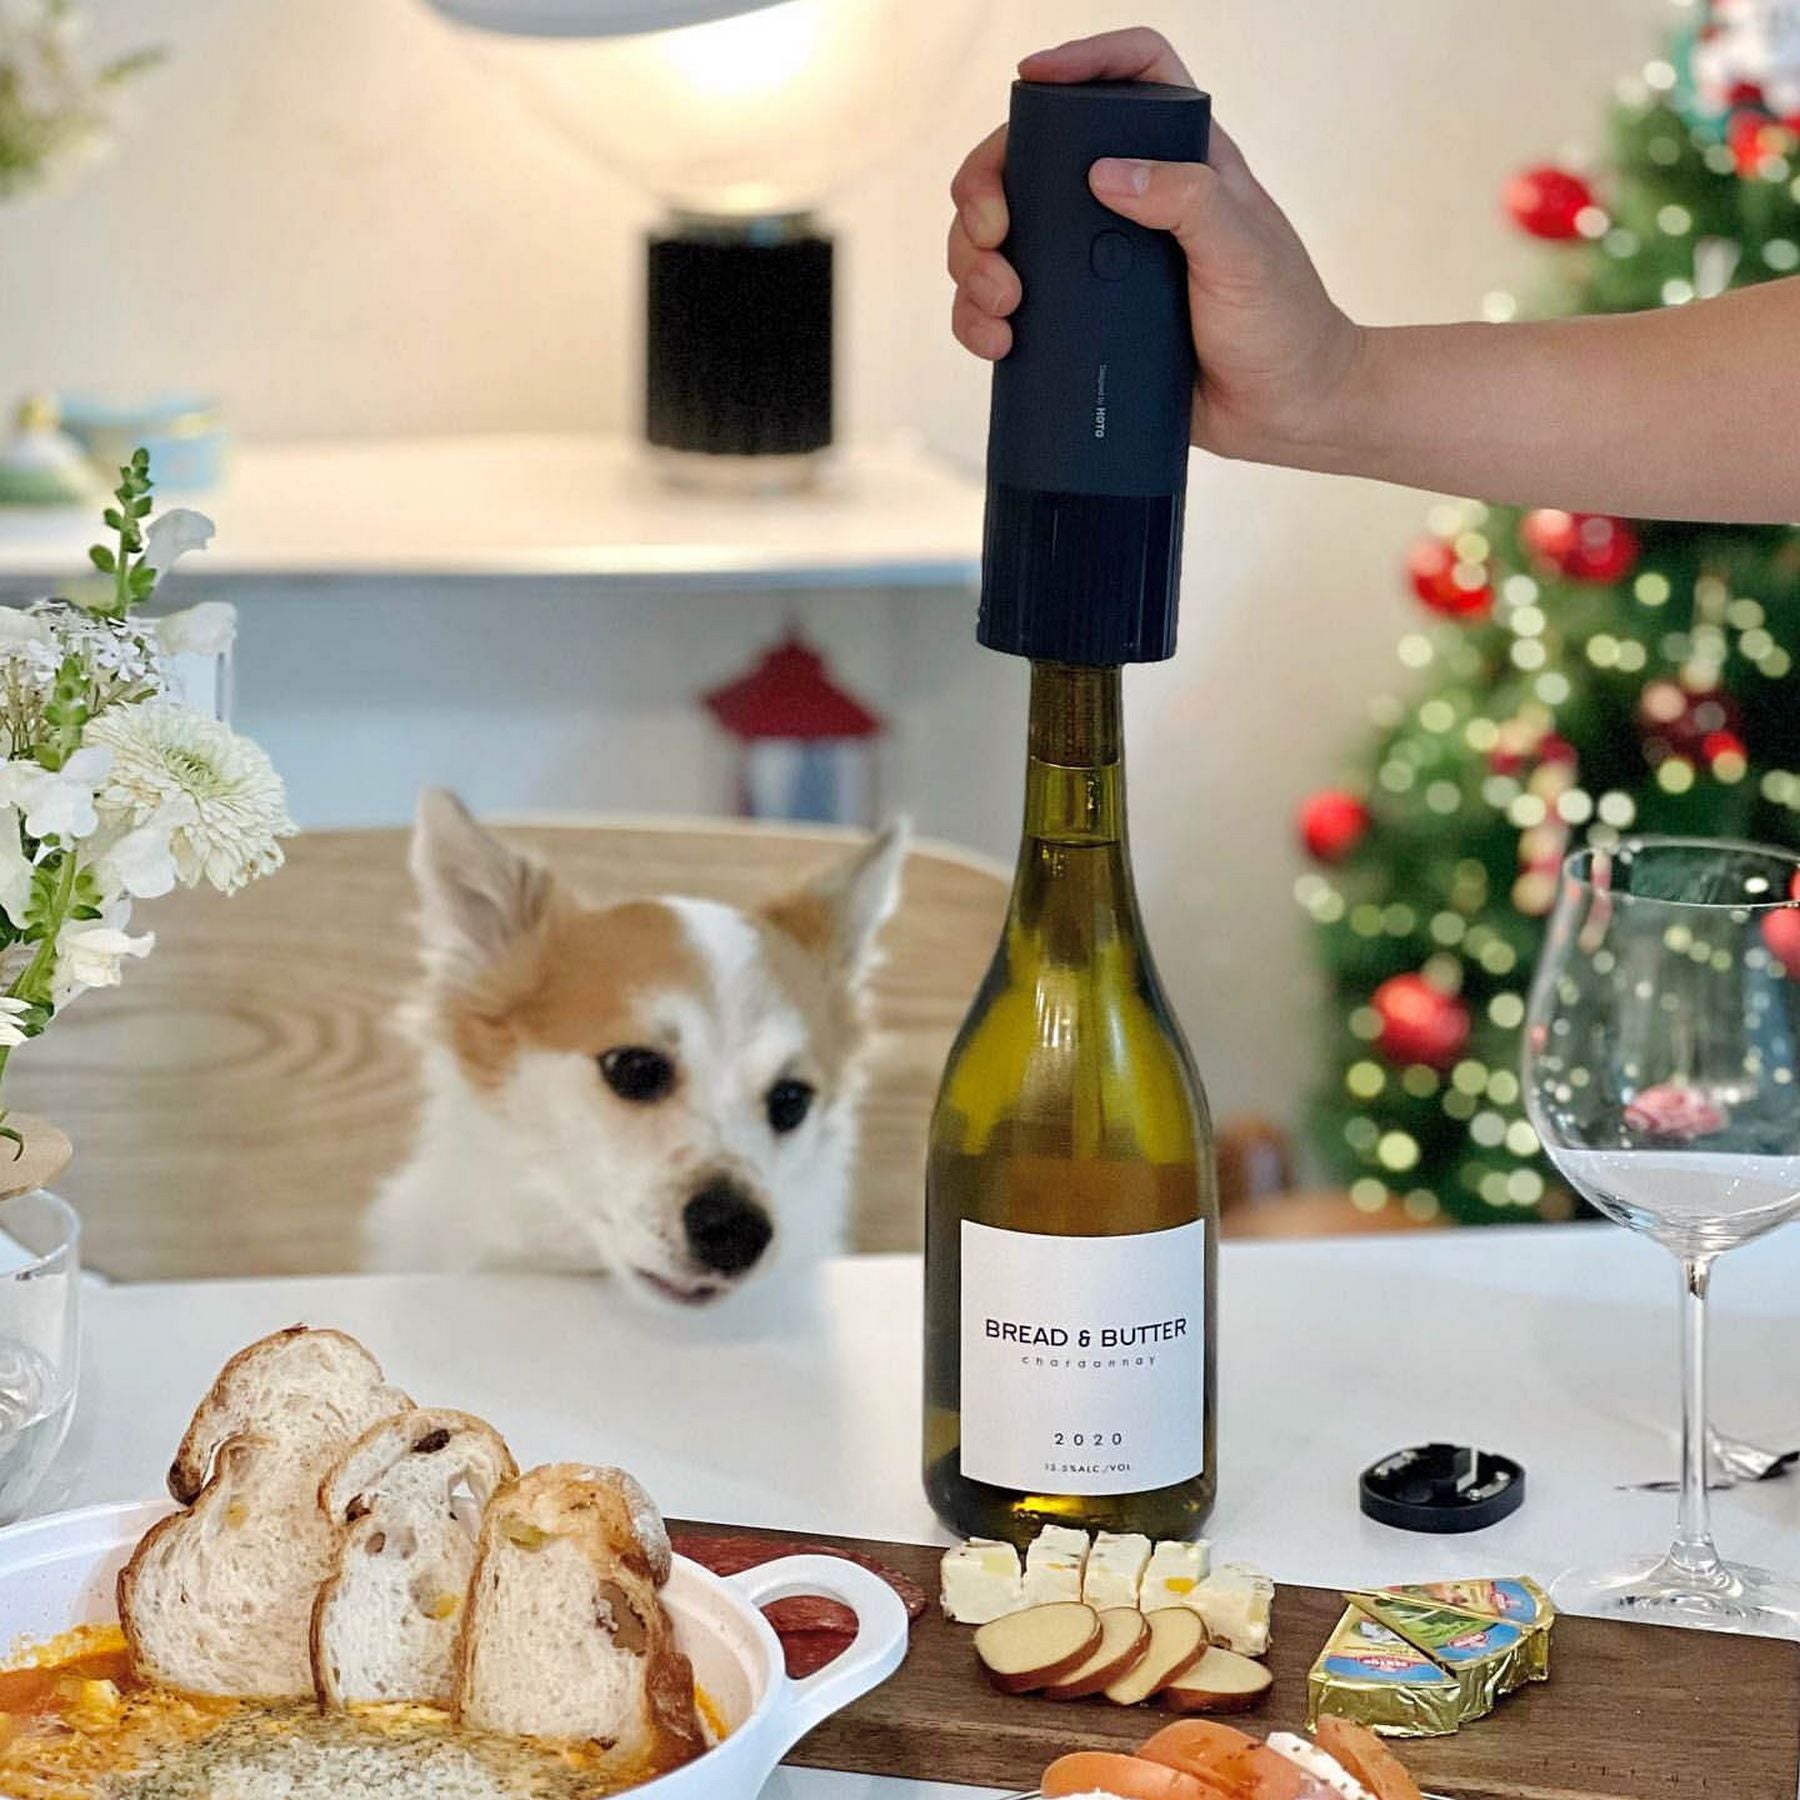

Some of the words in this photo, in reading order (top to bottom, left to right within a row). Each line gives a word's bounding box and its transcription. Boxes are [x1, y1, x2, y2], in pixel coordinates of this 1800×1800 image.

[1094, 407, 1106, 438] HOTO
[985, 1318, 1068, 1347] BREAD
[1078, 1329, 1091, 1347] &
[1101, 1317, 1187, 1347] BUTTER
[1054, 1432, 1122, 1446] 2020
